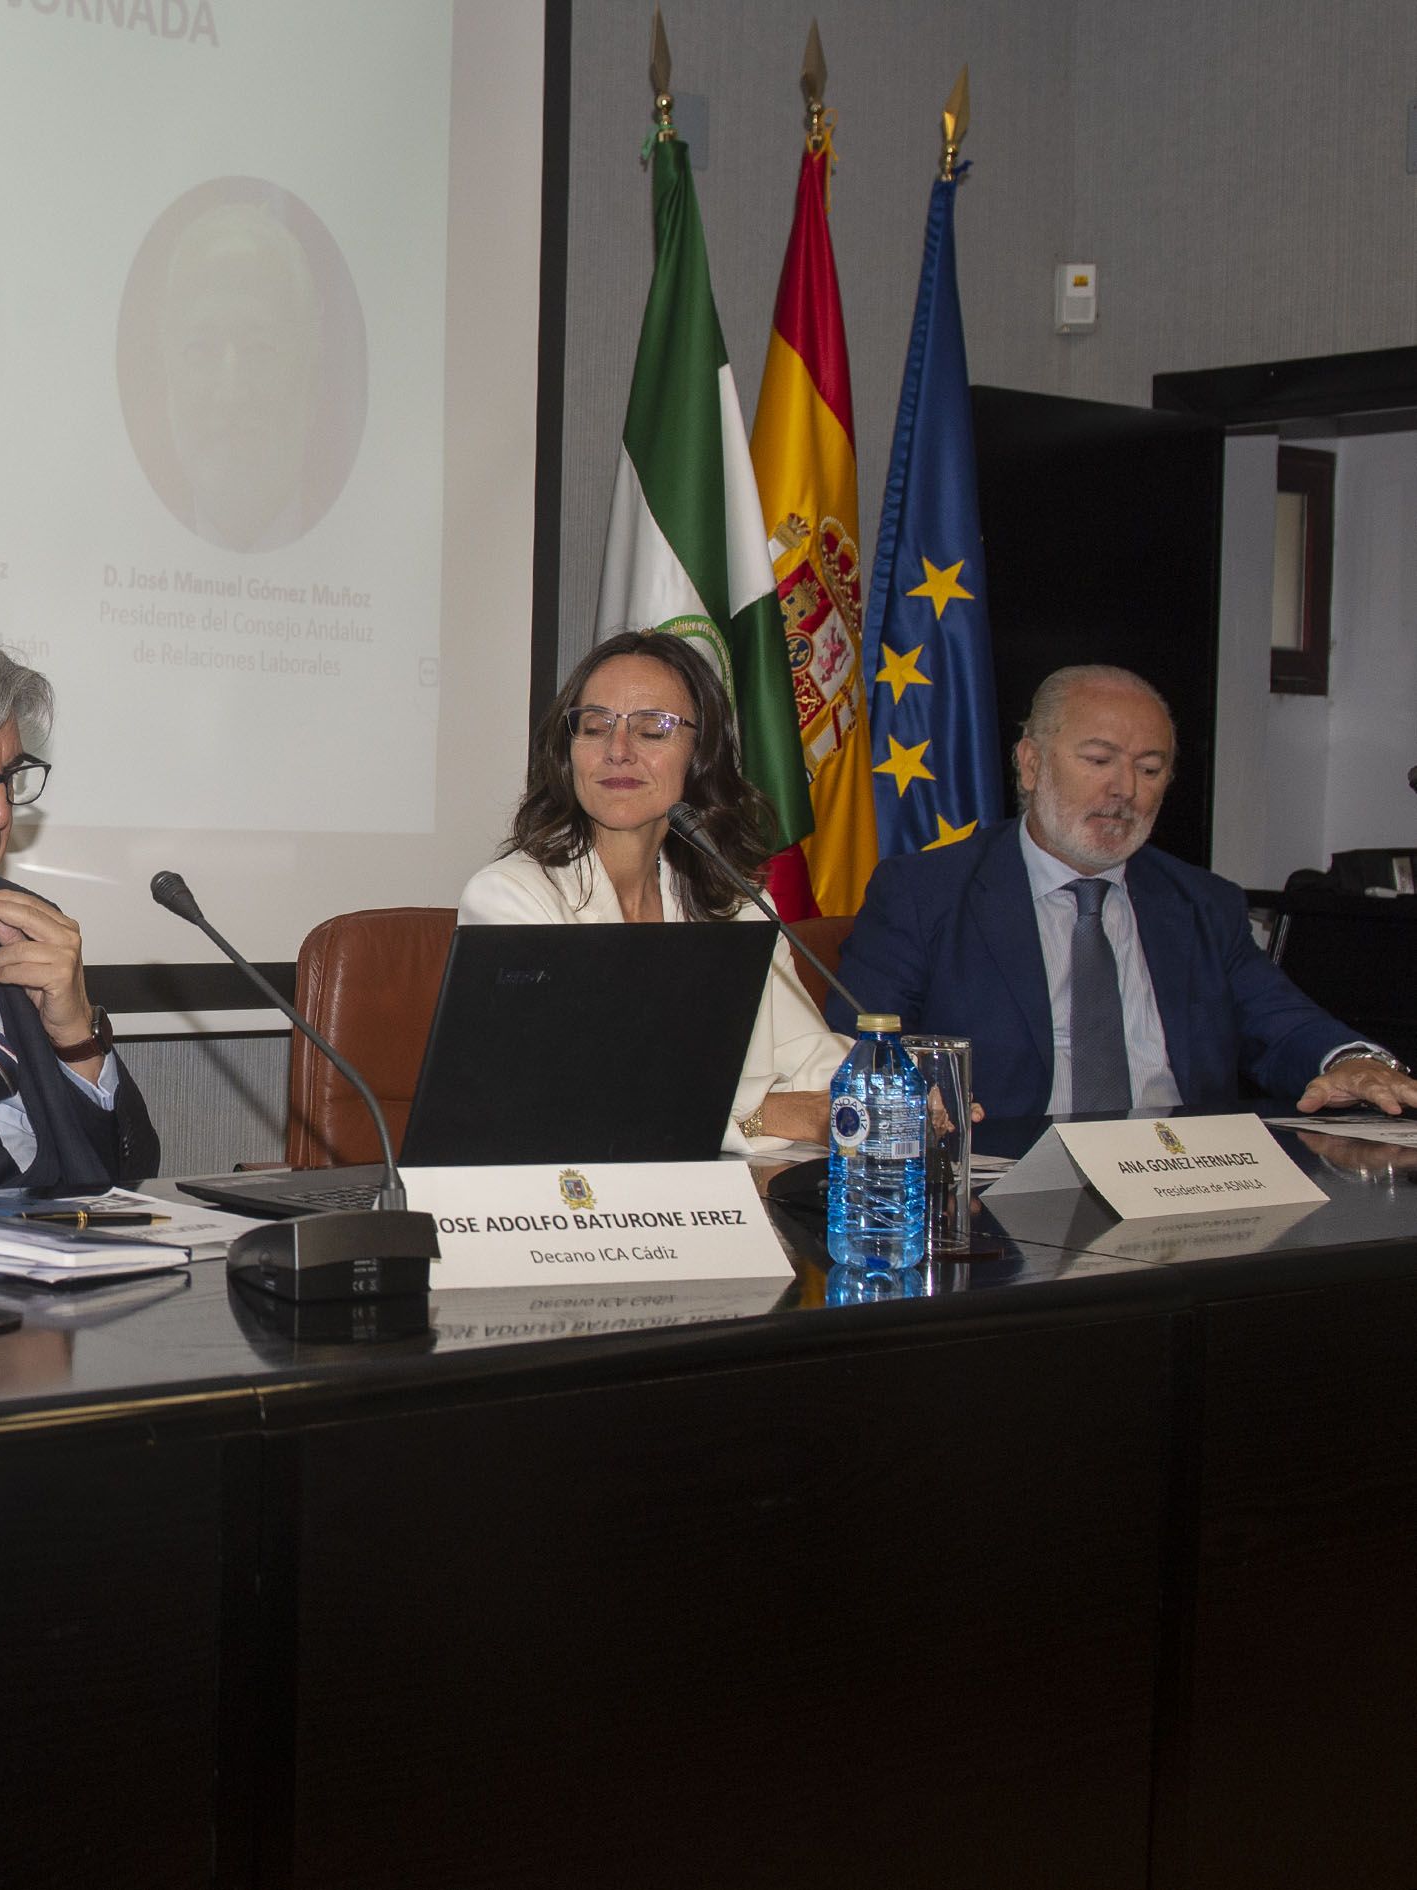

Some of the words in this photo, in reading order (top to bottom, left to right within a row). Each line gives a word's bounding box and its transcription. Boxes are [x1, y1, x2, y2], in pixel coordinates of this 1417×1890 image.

[102, 564, 123, 589] D.
[128, 567, 169, 592] José
[173, 572, 242, 598] Manuel
[246, 577, 307, 605] Gómez
[312, 583, 372, 610] Muñoz
[99, 600, 196, 630] Presidente
[202, 607, 228, 632] del
[233, 611, 302, 642] Consejo
[305, 619, 375, 645] Andaluz
[132, 641, 156, 666] de
[160, 643, 256, 673] Relaciones
[259, 650, 342, 679] Laborales
[1117, 1159, 1147, 1175] ANA
[1147, 1156, 1193, 1172] GOMEZ
[1193, 1152, 1259, 1169] HERNADEZ
[1153, 1183, 1210, 1198] Presidenta
[1211, 1182, 1223, 1194] de
[1224, 1177, 1266, 1191] ASNALA
[486, 1214, 569, 1233] ADOLFO
[575, 1211, 686, 1231] BATURONE
[689, 1209, 747, 1228] JEREZ
[530, 1249, 595, 1266] Decano
[600, 1247, 629, 1263] ICA
[632, 1245, 678, 1262] Cádiz
